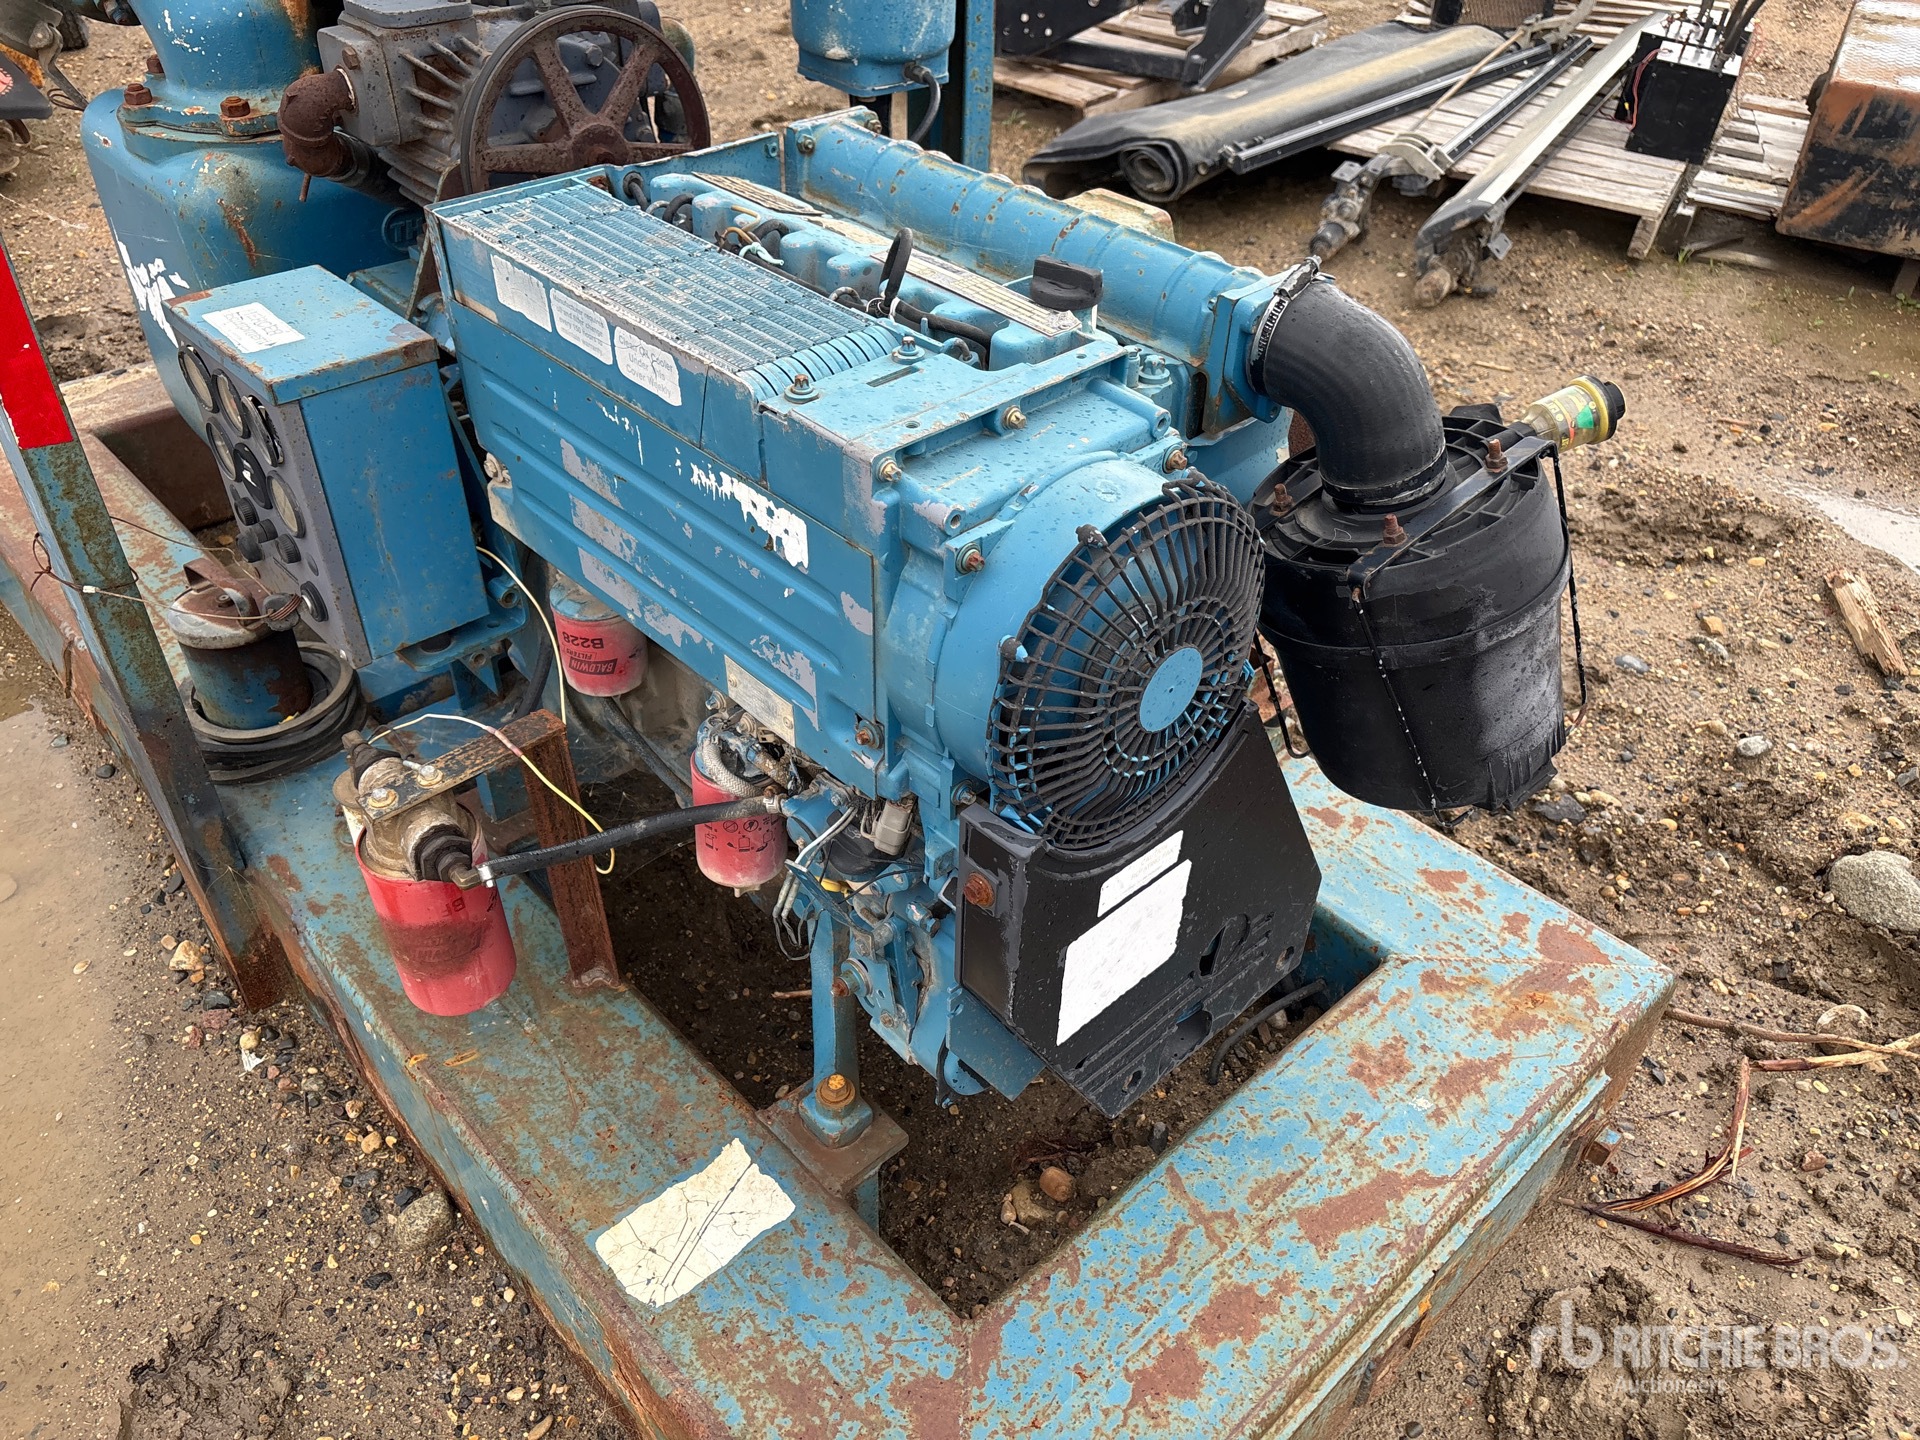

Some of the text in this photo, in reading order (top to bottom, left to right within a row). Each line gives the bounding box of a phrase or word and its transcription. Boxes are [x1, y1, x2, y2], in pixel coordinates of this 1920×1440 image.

[628, 352, 649, 370] Under
[625, 363, 646, 380] Cover
[562, 631, 604, 649] B228
[566, 648, 593, 660] FILTERS
[570, 659, 614, 673] BALDWIN
